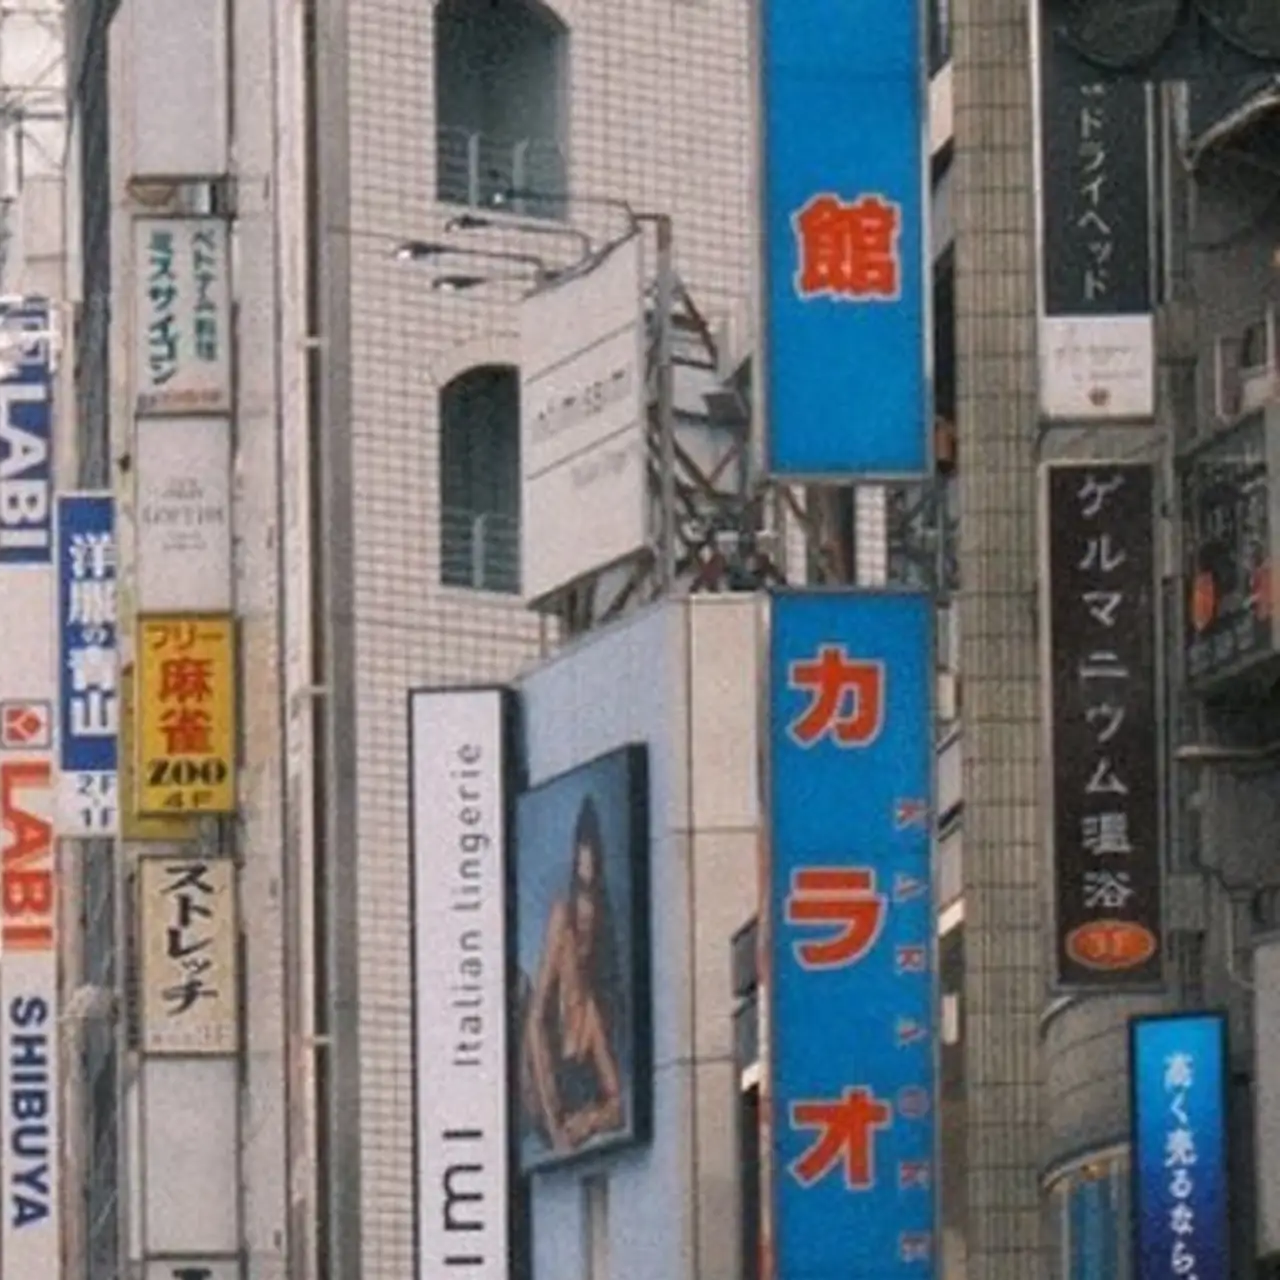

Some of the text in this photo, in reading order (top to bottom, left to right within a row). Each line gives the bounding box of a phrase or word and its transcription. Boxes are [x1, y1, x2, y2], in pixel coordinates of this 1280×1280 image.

[794, 194, 900, 298] 館
[68, 533, 116, 737] 洋服の青山
[145, 625, 226, 651] フリー
[158, 656, 216, 755] 麻雀
[1076, 473, 1134, 910] ゲルマニウム温浴
[447, 742, 491, 913] lingerie
[159, 863, 219, 1015] ストレッチ
[450, 930, 486, 1068] Italian
[9, 996, 50, 1227] SHIBUYA
